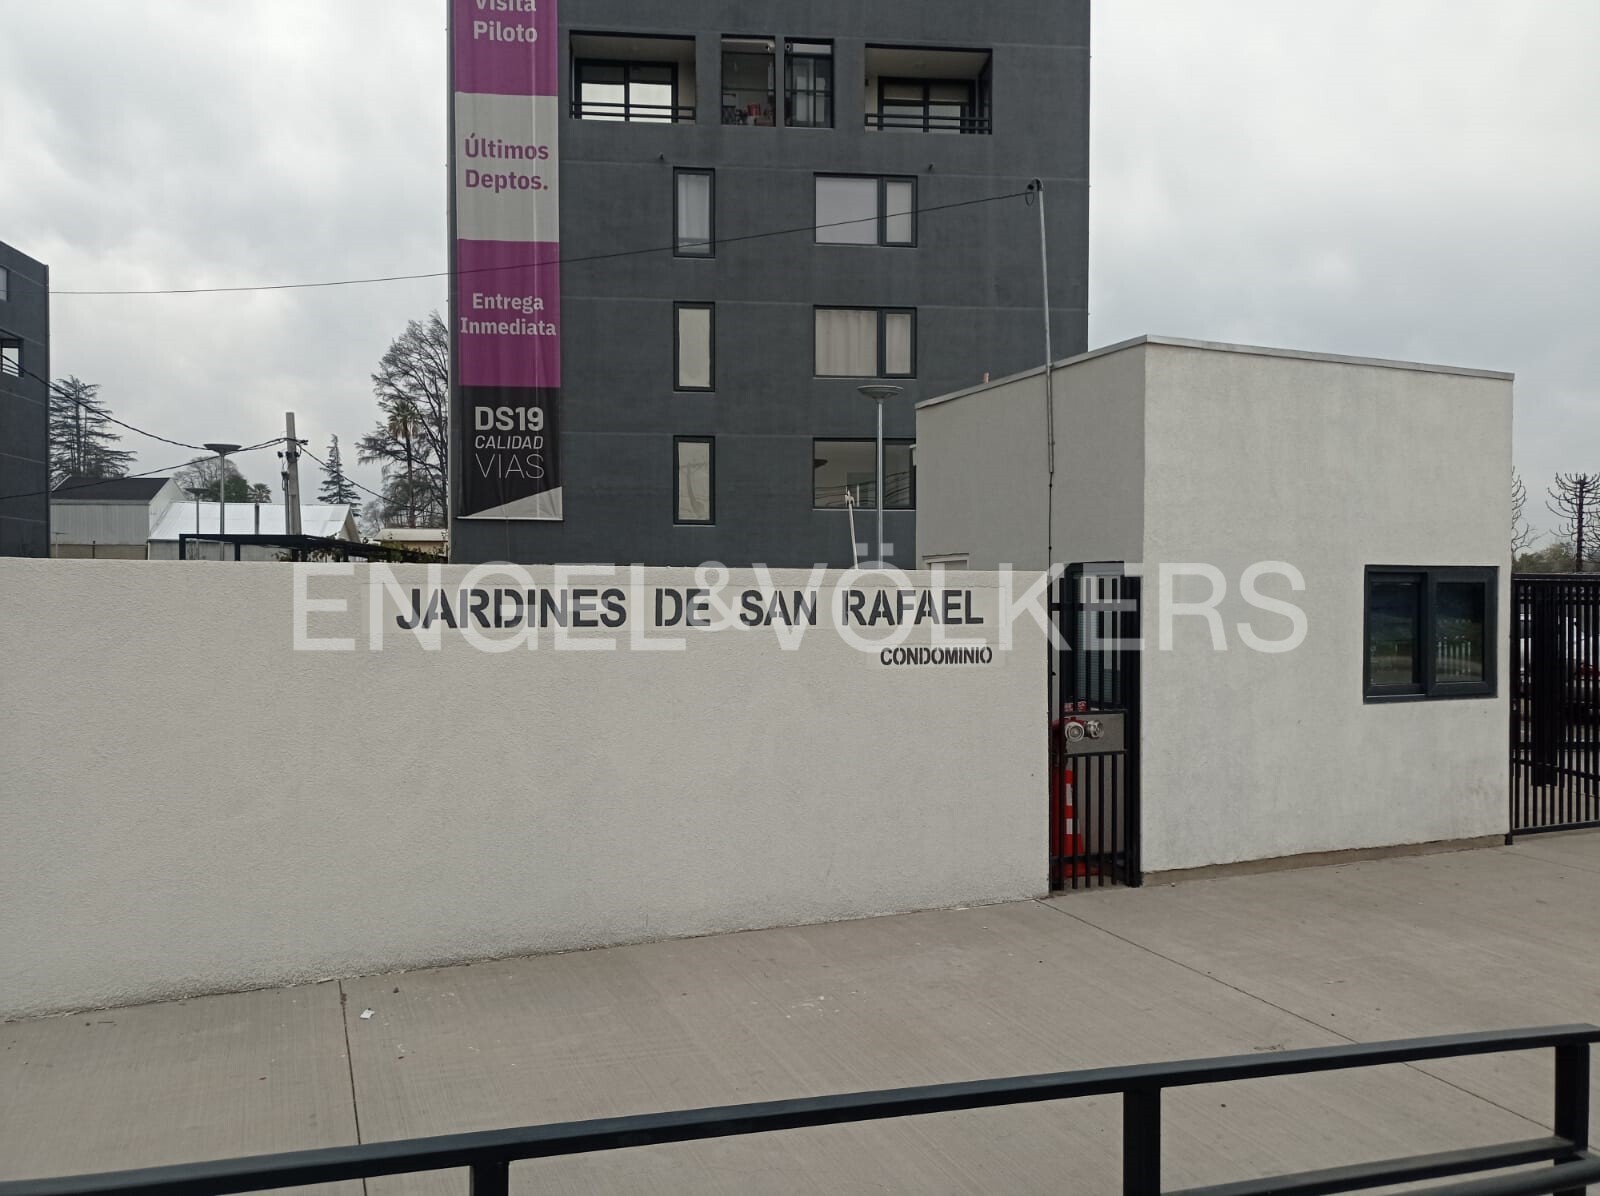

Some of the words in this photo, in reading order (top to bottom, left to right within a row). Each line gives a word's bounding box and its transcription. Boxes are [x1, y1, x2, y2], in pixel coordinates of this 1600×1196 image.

[473, 20, 538, 43] Piloto
[465, 132, 549, 160] Últimos
[465, 168, 549, 193] Deptos.
[472, 293, 545, 314] Entrega
[460, 317, 557, 336] Inmediata
[474, 406, 545, 431] DS19
[474, 435, 544, 450] CALIDAD
[475, 453, 545, 479] VIAS
[396, 587, 628, 630] JARDINES
[654, 587, 712, 627] DE
[739, 589, 818, 627] SAN
[841, 589, 985, 626] RAFAEL
[879, 646, 993, 666] CONDOMINIO
